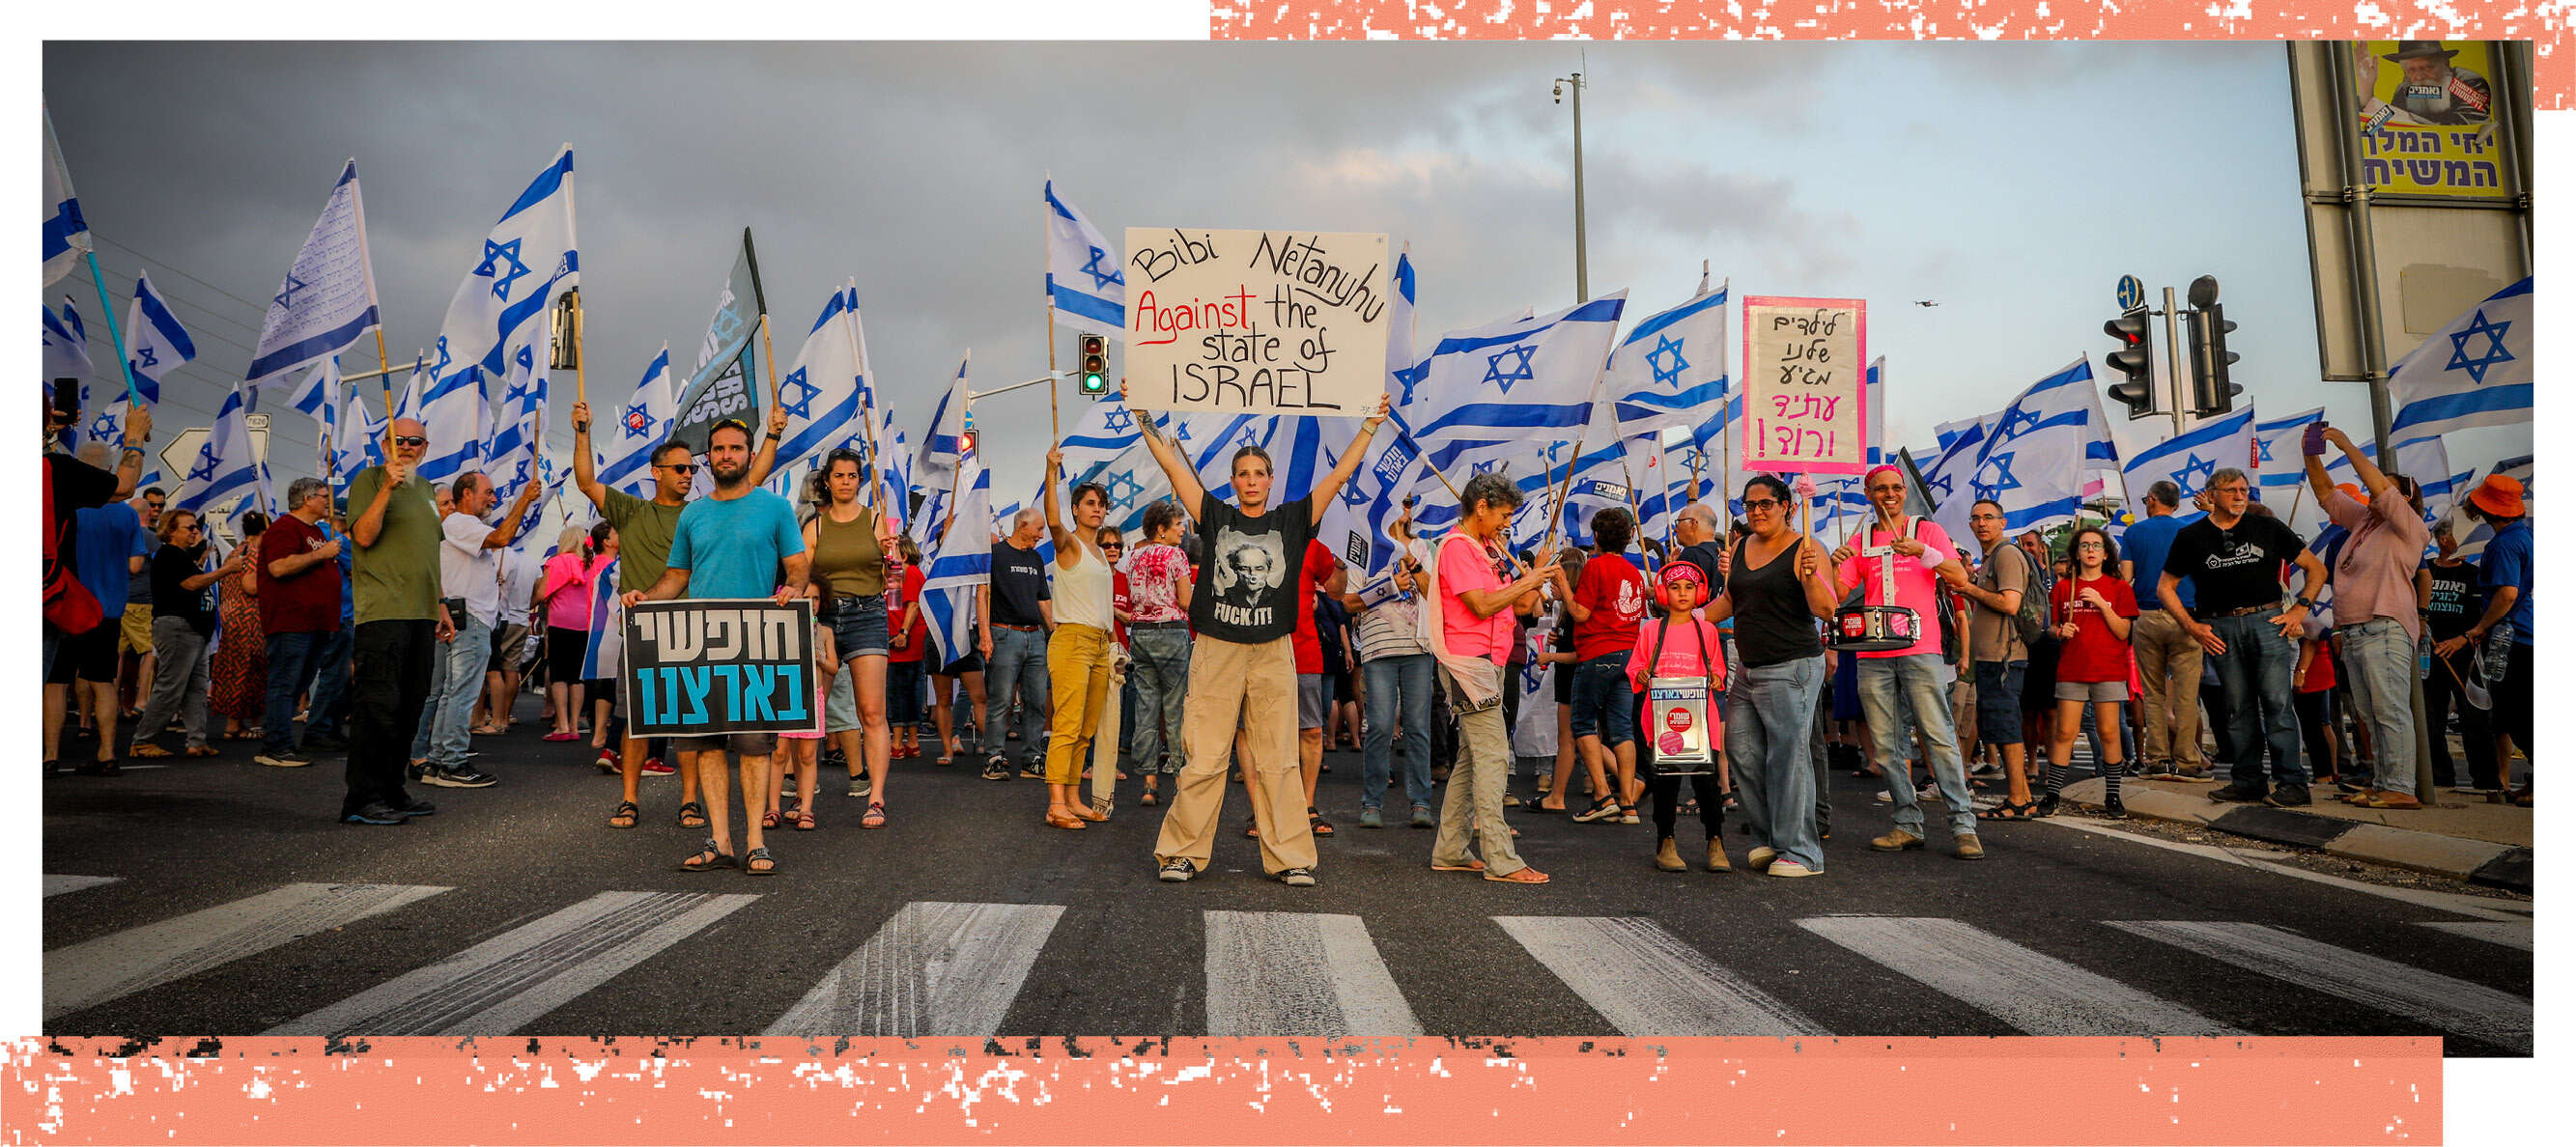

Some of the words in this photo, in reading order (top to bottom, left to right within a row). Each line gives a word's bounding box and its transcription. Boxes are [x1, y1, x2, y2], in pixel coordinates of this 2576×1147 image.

[2408, 85, 2441, 95] נאמנים
[2366, 106, 2391, 132] נאמנים
[2361, 126, 2443, 155] המלך
[2449, 131, 2494, 154] יחי
[2364, 158, 2499, 187] המשיח
[1131, 228, 1219, 283] Bibi
[1250, 232, 1385, 322] Netanyhu
[1136, 284, 1257, 346] Against
[1264, 284, 1317, 328] the
[1773, 308, 1845, 336] לילדים
[1203, 322, 1280, 364] state
[1293, 326, 1337, 373] of
[1781, 339, 1830, 363] שלנו
[1173, 363, 1342, 410] ISRAEL
[1779, 365, 1831, 385] מגיע
[1771, 392, 1841, 422] עתיד
[1376, 445, 1401, 474] חופשי
[1595, 482, 1628, 496] נאמנים
[2432, 579, 2467, 595] נאמנ
[1214, 602, 1252, 626] FUCK
[1254, 606, 1273, 626] IT!
[635, 610, 800, 662] חופשי
[637, 664, 807, 725] בארצנו
